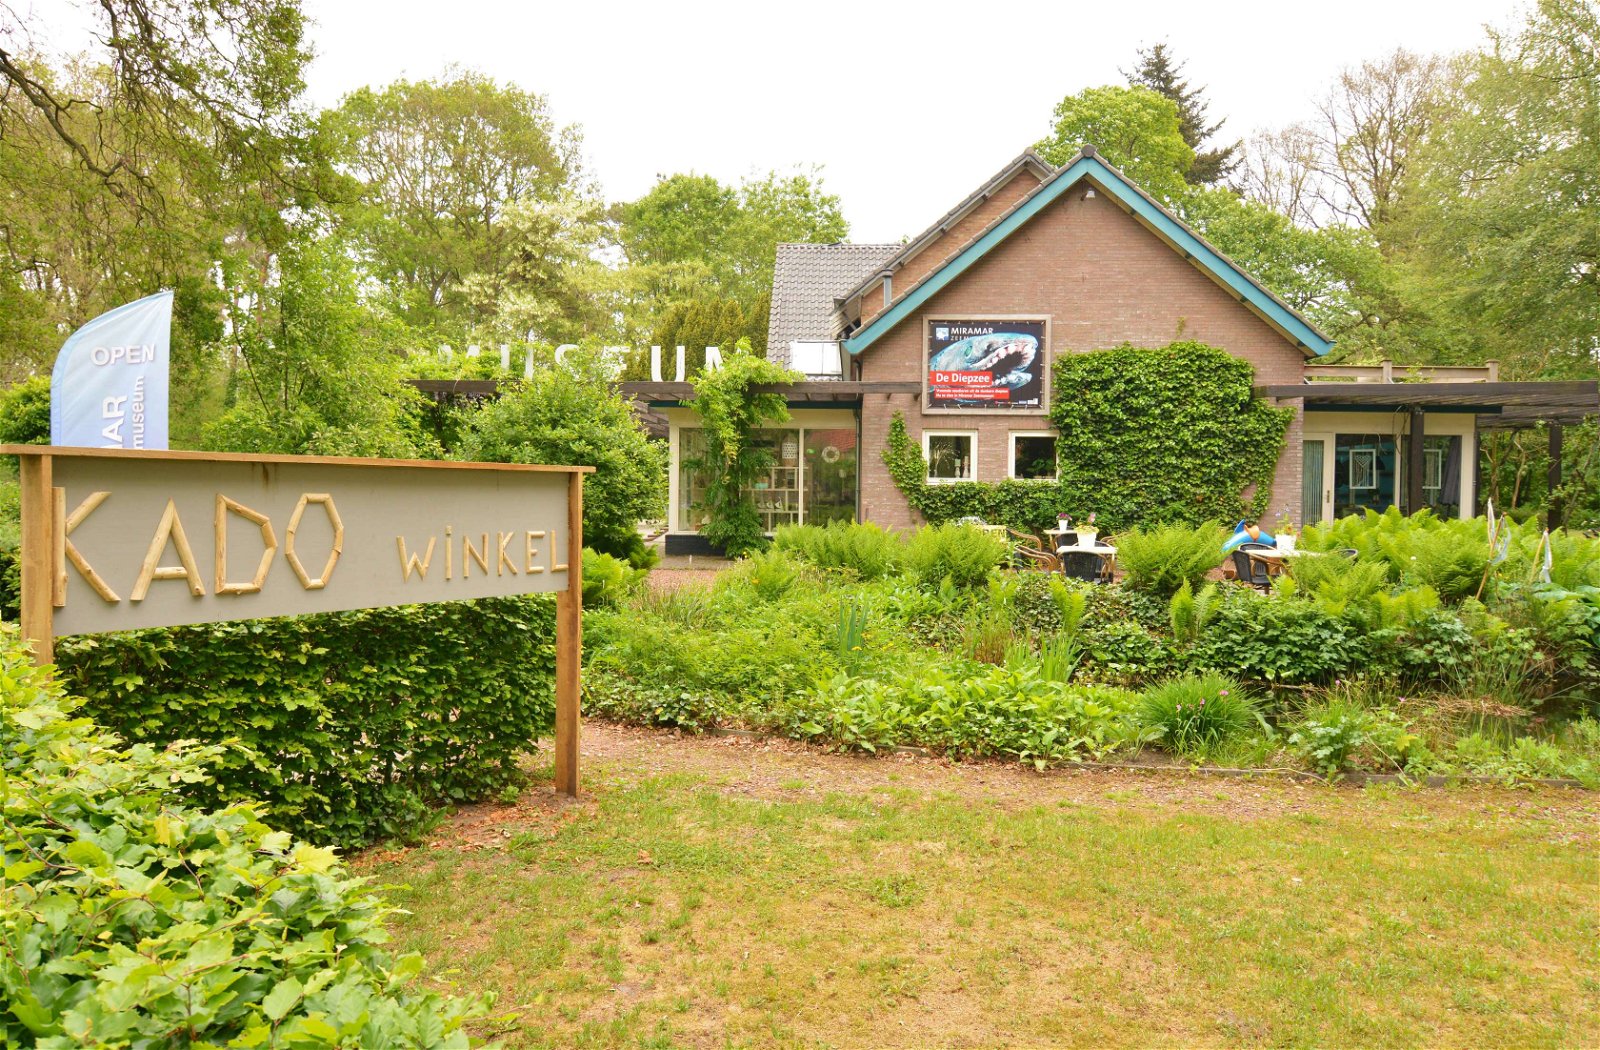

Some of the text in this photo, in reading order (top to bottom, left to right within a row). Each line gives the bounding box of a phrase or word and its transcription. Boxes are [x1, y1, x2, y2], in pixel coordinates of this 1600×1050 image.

[950, 327, 994, 335] MIRAMAR
[90, 344, 156, 366] OPEN
[936, 373, 990, 384] De Diepzee
[102, 395, 128, 448] AR
[132, 376, 145, 449] museum
[52, 487, 345, 607] KADO
